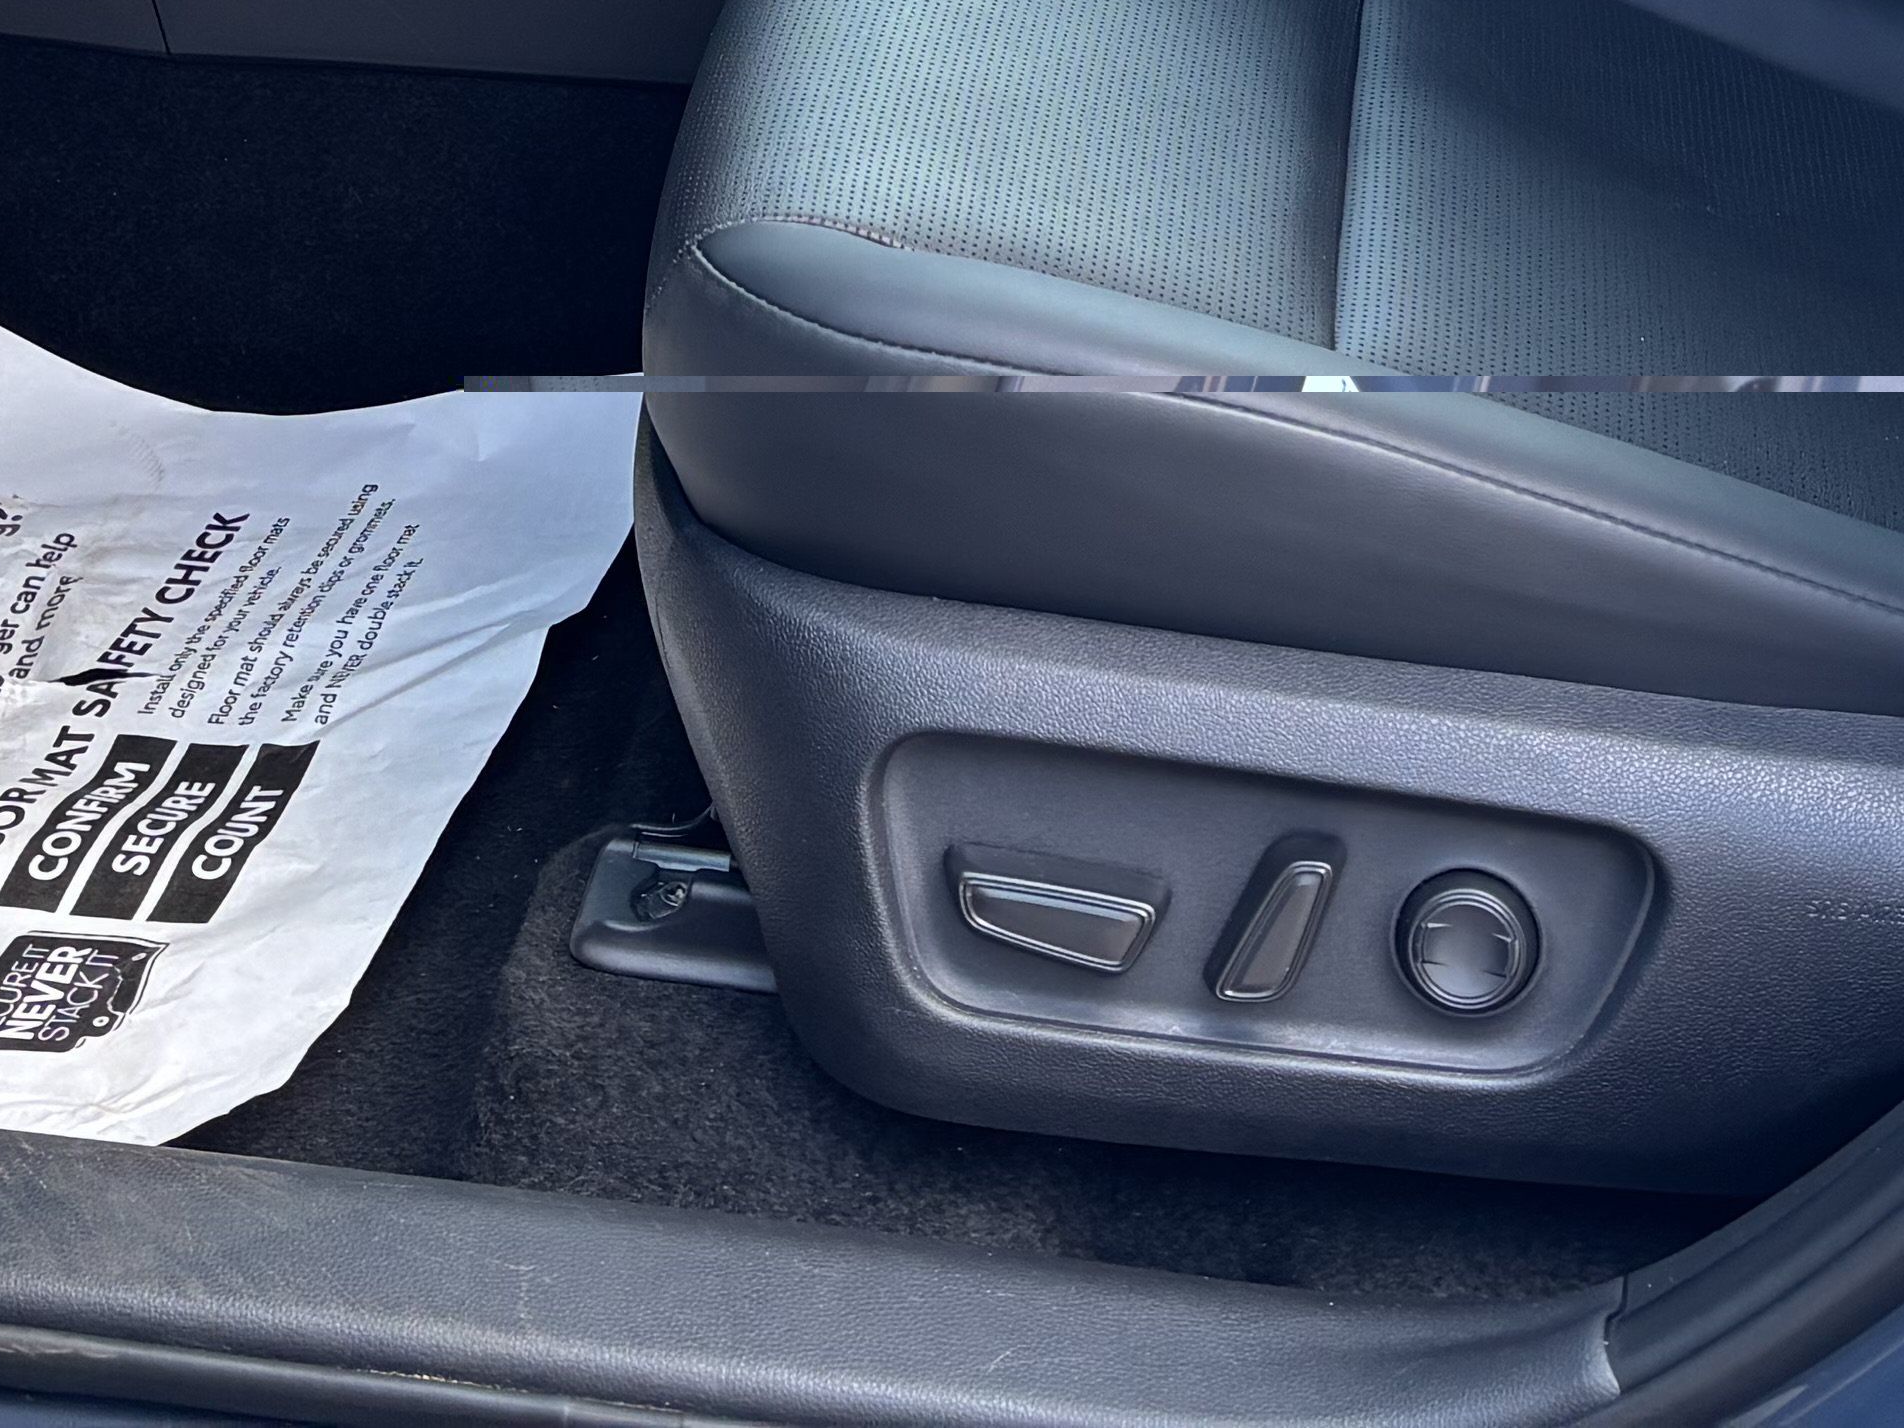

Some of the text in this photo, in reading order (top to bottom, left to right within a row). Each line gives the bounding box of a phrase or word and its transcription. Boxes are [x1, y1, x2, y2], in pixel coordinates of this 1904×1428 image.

[10, 575, 45, 614] can
[25, 533, 77, 569] help
[362, 574, 384, 596] one
[373, 547, 403, 571] floor
[137, 518, 290, 714] Install only the specified floor mats
[208, 689, 240, 724] Floor
[233, 655, 257, 686] mat
[248, 613, 285, 653] should
[301, 560, 323, 574] be
[348, 484, 378, 515] using
[315, 693, 337, 724] and
[357, 601, 393, 650] double
[387, 569, 416, 598] stack
[325, 630, 348, 657] you
[336, 597, 367, 624] have
[8, 636, 44, 678] and
[16, 724, 95, 789] MAT
[72, 607, 174, 717] SAFETY
[155, 512, 250, 604] CHECK
[169, 654, 216, 718] designed
[206, 635, 229, 651] for
[223, 609, 250, 632] your
[238, 702, 262, 725] the
[251, 651, 293, 698] factory
[282, 595, 326, 647] retention
[281, 684, 313, 721] Make
[28, 761, 150, 880] CONFIRM
[112, 780, 215, 876] SECURE
[192, 786, 284, 880] COUNT
[22, 944, 49, 959] IT
[38, 949, 119, 1041] STACK IT
